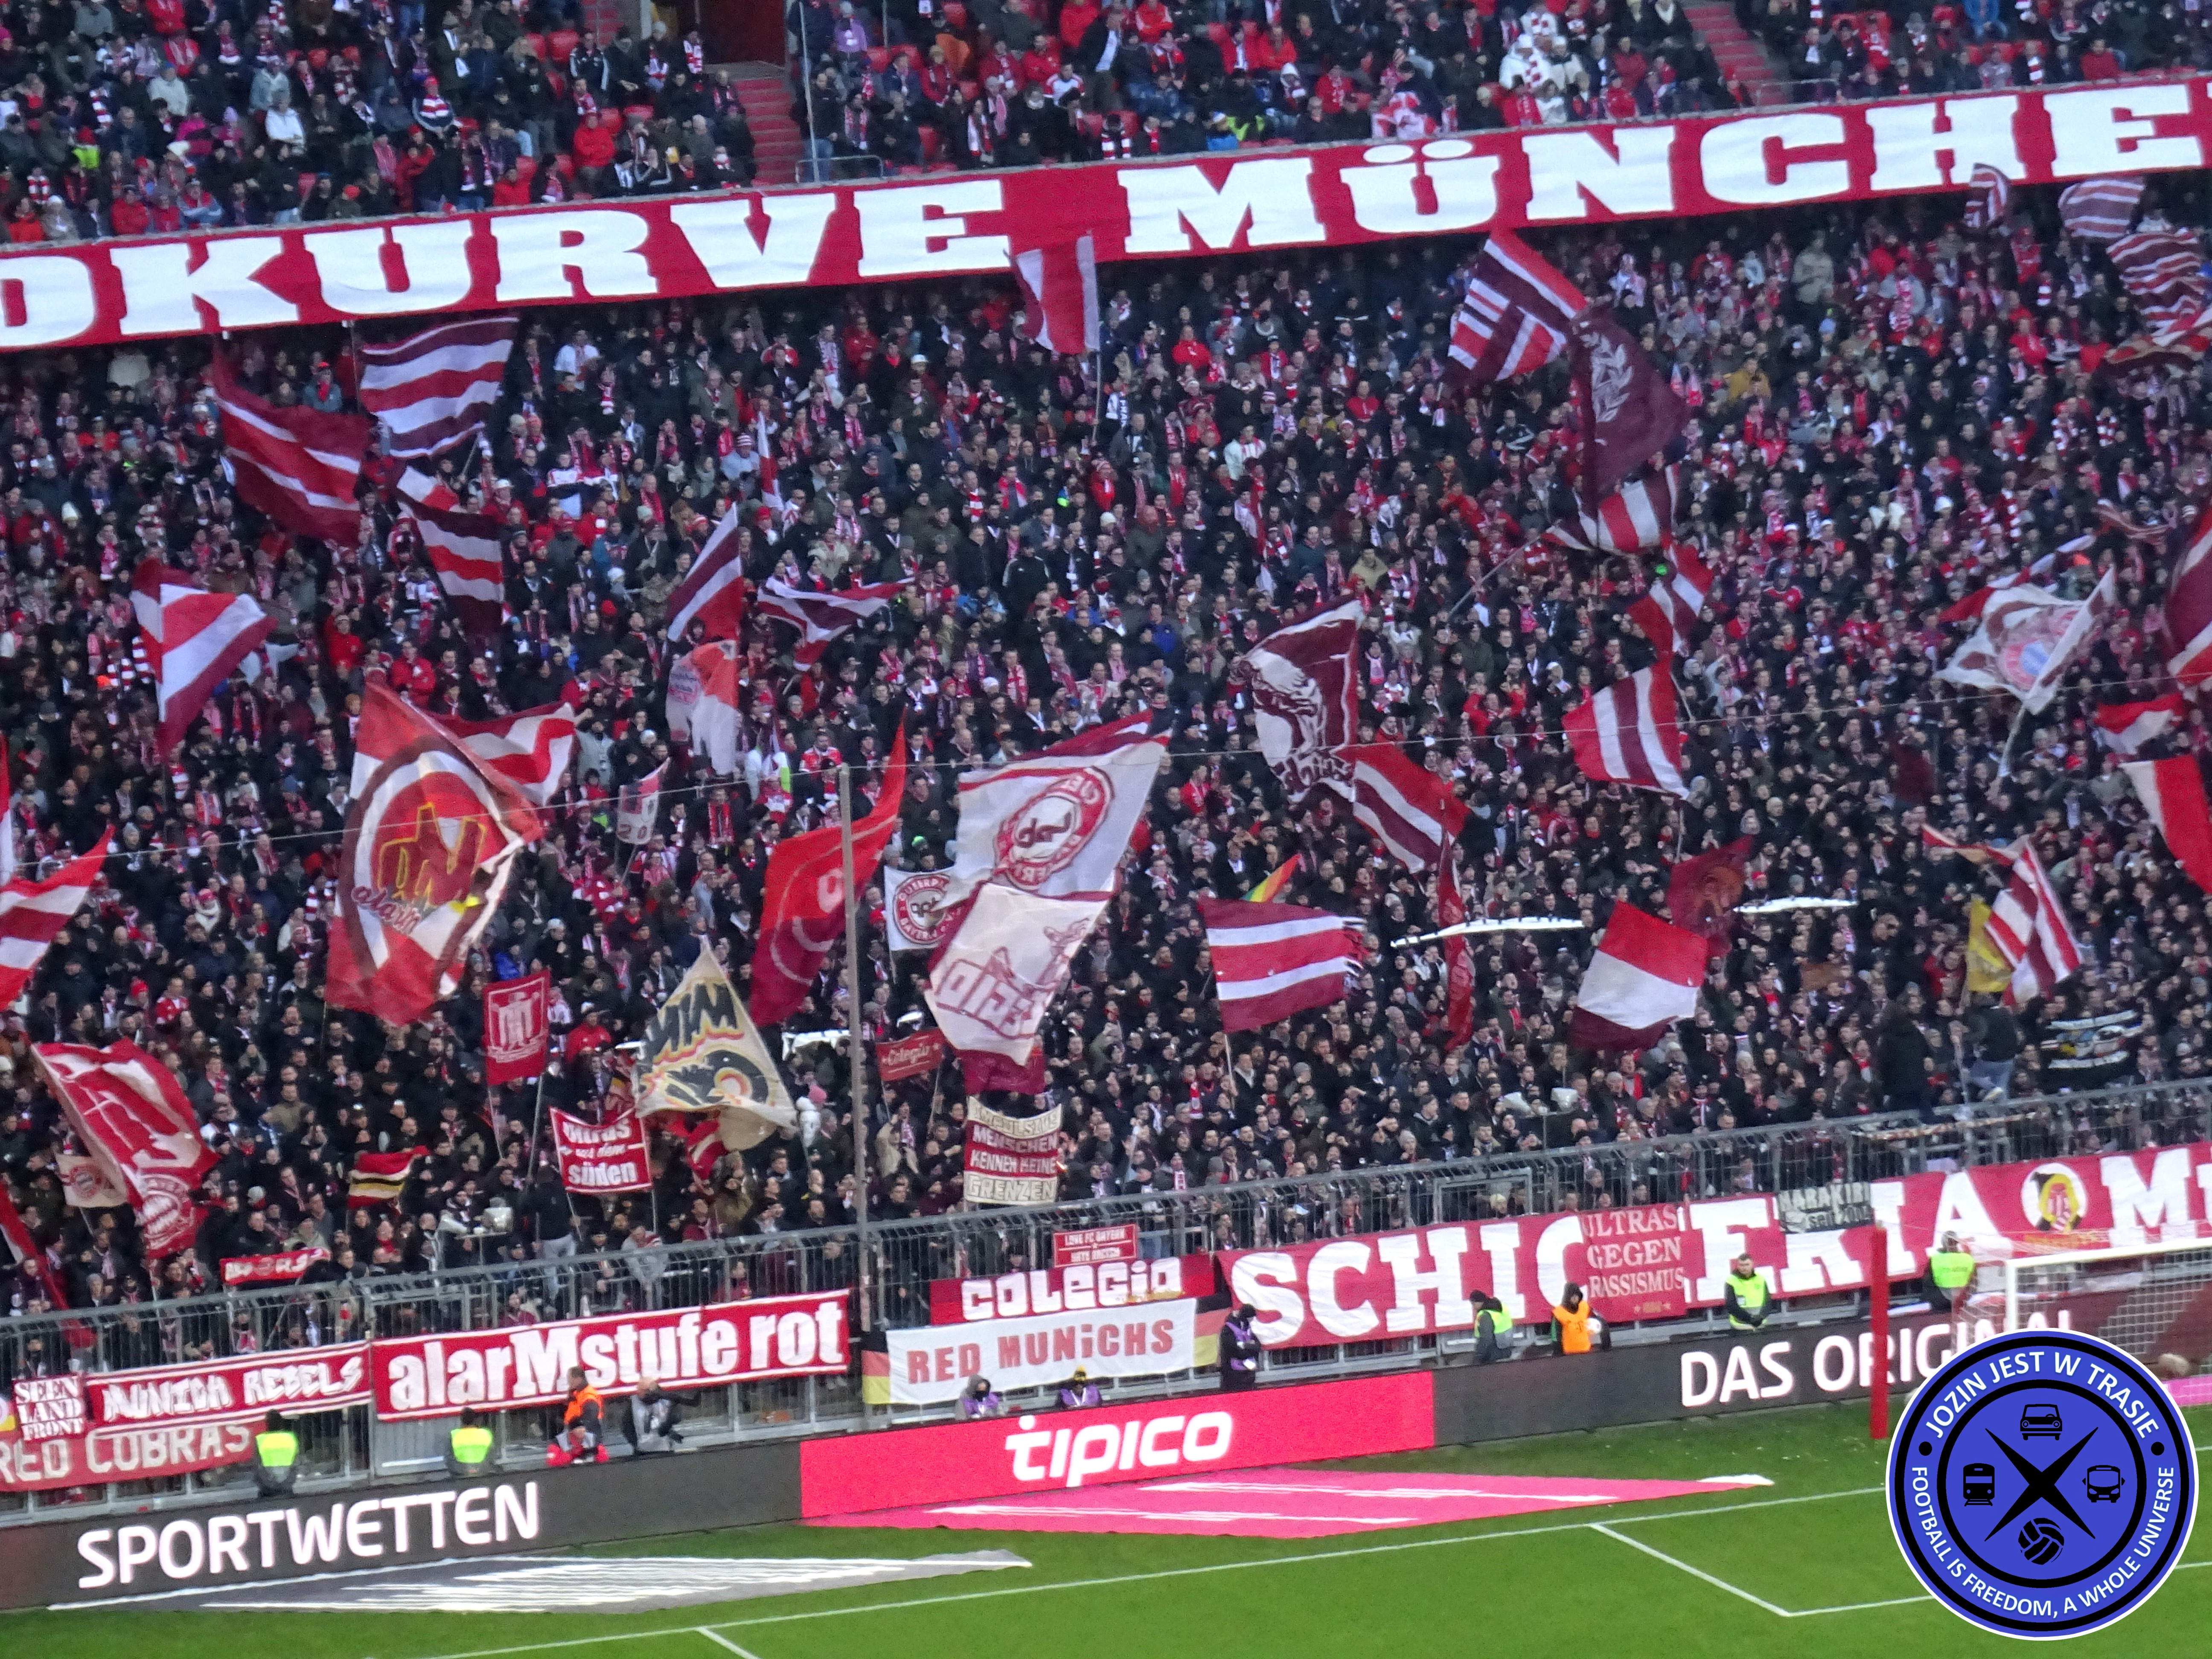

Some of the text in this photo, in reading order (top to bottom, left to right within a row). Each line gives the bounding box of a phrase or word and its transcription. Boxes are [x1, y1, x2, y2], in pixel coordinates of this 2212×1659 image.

[1117, 81, 2212, 253] MÜNCHE
[972, 1124, 1059, 1153] MENSCHEN
[969, 1175, 1057, 1202] GRENZEN
[1580, 1204, 1677, 1237] ULTRAS
[1587, 1236, 1682, 1269] GEGEN
[1589, 1266, 1686, 1298] RASSISMUS
[750, 1301, 844, 1369] rot
[243, 1356, 364, 1405] REBELS
[907, 1343, 981, 1384] RED
[1680, 1340, 1794, 1407] DAS
[14, 1376, 79, 1404] SEEN
[17, 1397, 82, 1424] LAND
[21, 1417, 83, 1441] FRONT
[85, 1423, 251, 1474] COBRAS
[1004, 1410, 1233, 1487] tipico
[77, 1481, 539, 1589] SPORTWETTEN
